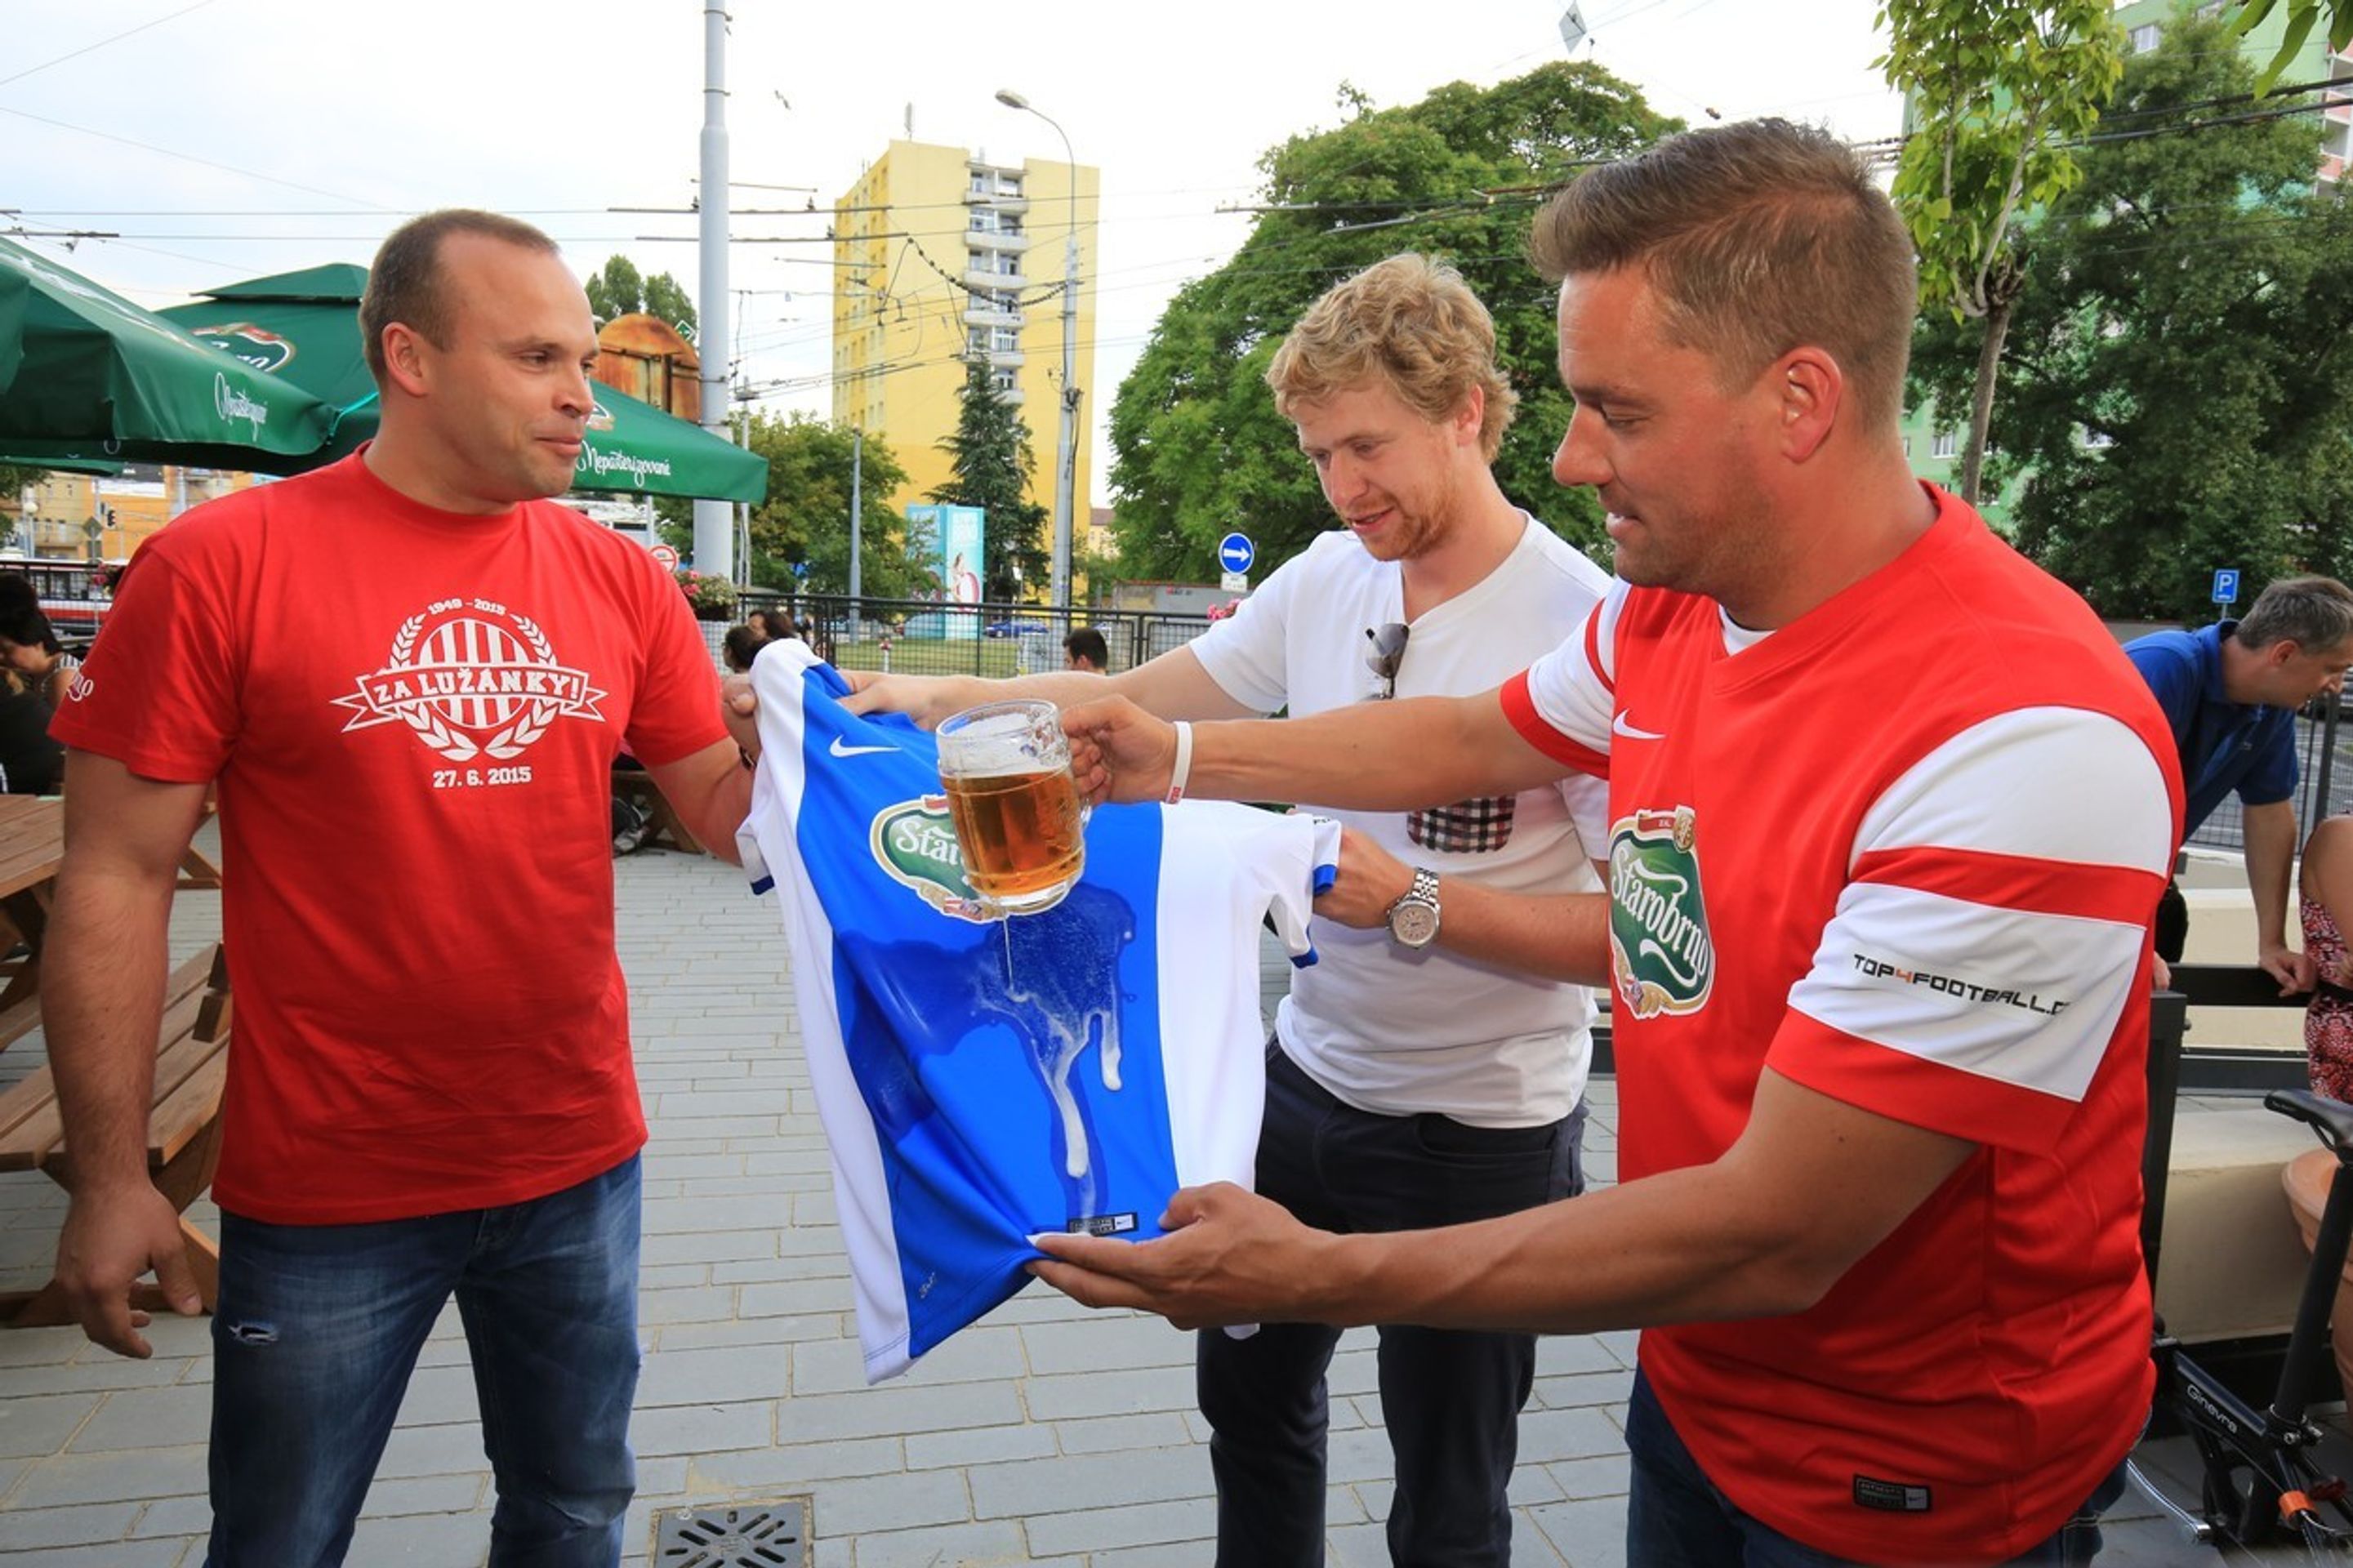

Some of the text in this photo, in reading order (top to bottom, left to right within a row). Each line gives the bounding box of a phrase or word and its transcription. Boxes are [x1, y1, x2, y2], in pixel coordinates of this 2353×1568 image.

[2218, 574, 2233, 592] P
[373, 680, 413, 704] ZA
[433, 766, 532, 788] 27. 6. 2015
[1611, 845, 1709, 987] Starobrno
